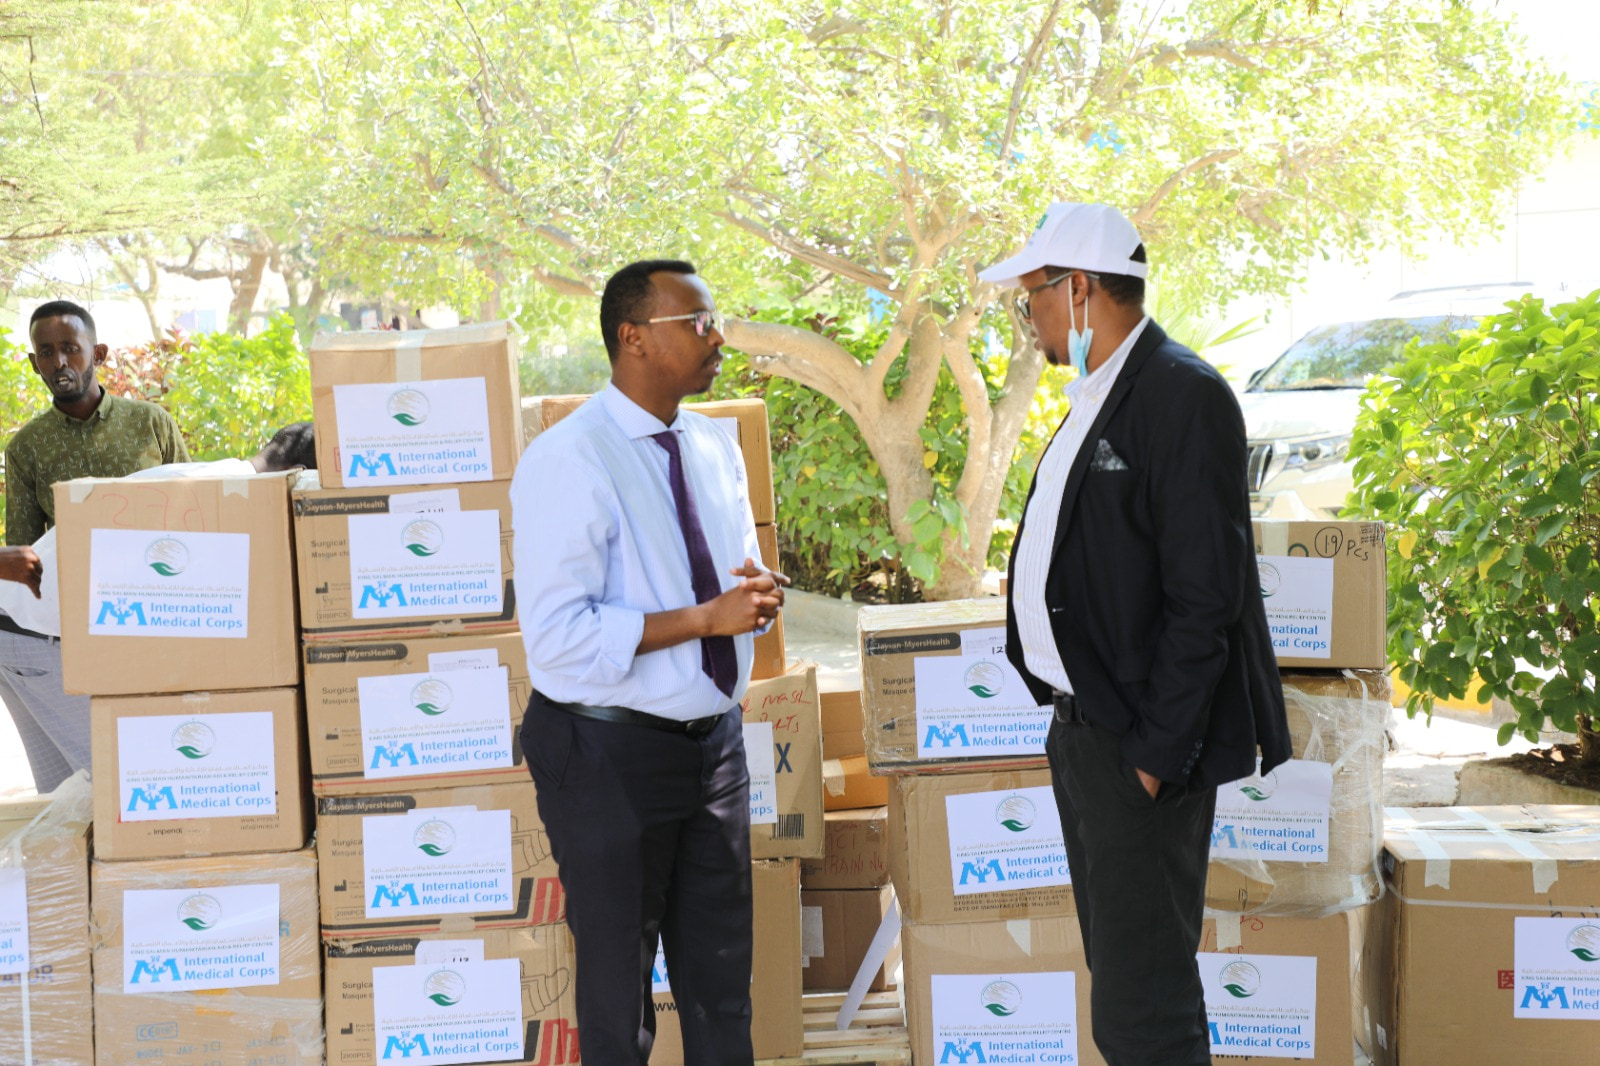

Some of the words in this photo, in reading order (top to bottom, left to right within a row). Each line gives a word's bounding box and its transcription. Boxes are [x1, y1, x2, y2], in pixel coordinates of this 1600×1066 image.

[397, 447, 476, 461] International
[398, 462, 446, 474] Medical
[451, 460, 486, 473] Corps
[409, 579, 487, 592] International
[410, 594, 457, 606] Medical
[462, 593, 498, 605] Corps
[150, 602, 232, 614] International
[150, 616, 200, 628] Medical
[206, 618, 242, 630] Corps
[1272, 624, 1318, 635] national
[1294, 638, 1327, 651] Corps
[972, 720, 1046, 732] International
[420, 735, 497, 751] International
[972, 734, 1018, 745] Medical
[1024, 735, 1047, 746] Cor
[421, 751, 468, 764] Medical
[473, 748, 508, 762] Corps
[179, 781, 260, 795] International
[180, 797, 230, 809] Medical
[235, 795, 271, 808] Corps
[750, 806, 773, 816] orps
[1292, 842, 1324, 854] Corps
[1006, 852, 1067, 867] Internatio
[1008, 866, 1054, 880] Medical
[421, 878, 498, 891] International
[422, 893, 469, 904] Medical
[474, 891, 508, 903] Corps
[0, 954, 24, 966] orps
[184, 952, 265, 966] International
[185, 968, 234, 981] Medical
[239, 966, 276, 979] Corps
[342, 982, 373, 990] Surgica
[1226, 1021, 1301, 1033] International
[432, 1027, 508, 1041] International
[433, 1042, 480, 1054] Medical
[485, 1040, 519, 1053] Corps
[988, 1039, 1063, 1049] International
[1225, 1035, 1271, 1046] Medical
[1276, 1037, 1310, 1049] Corps
[989, 1052, 1034, 1062] Medical
[1039, 1052, 1072, 1063] Corps
